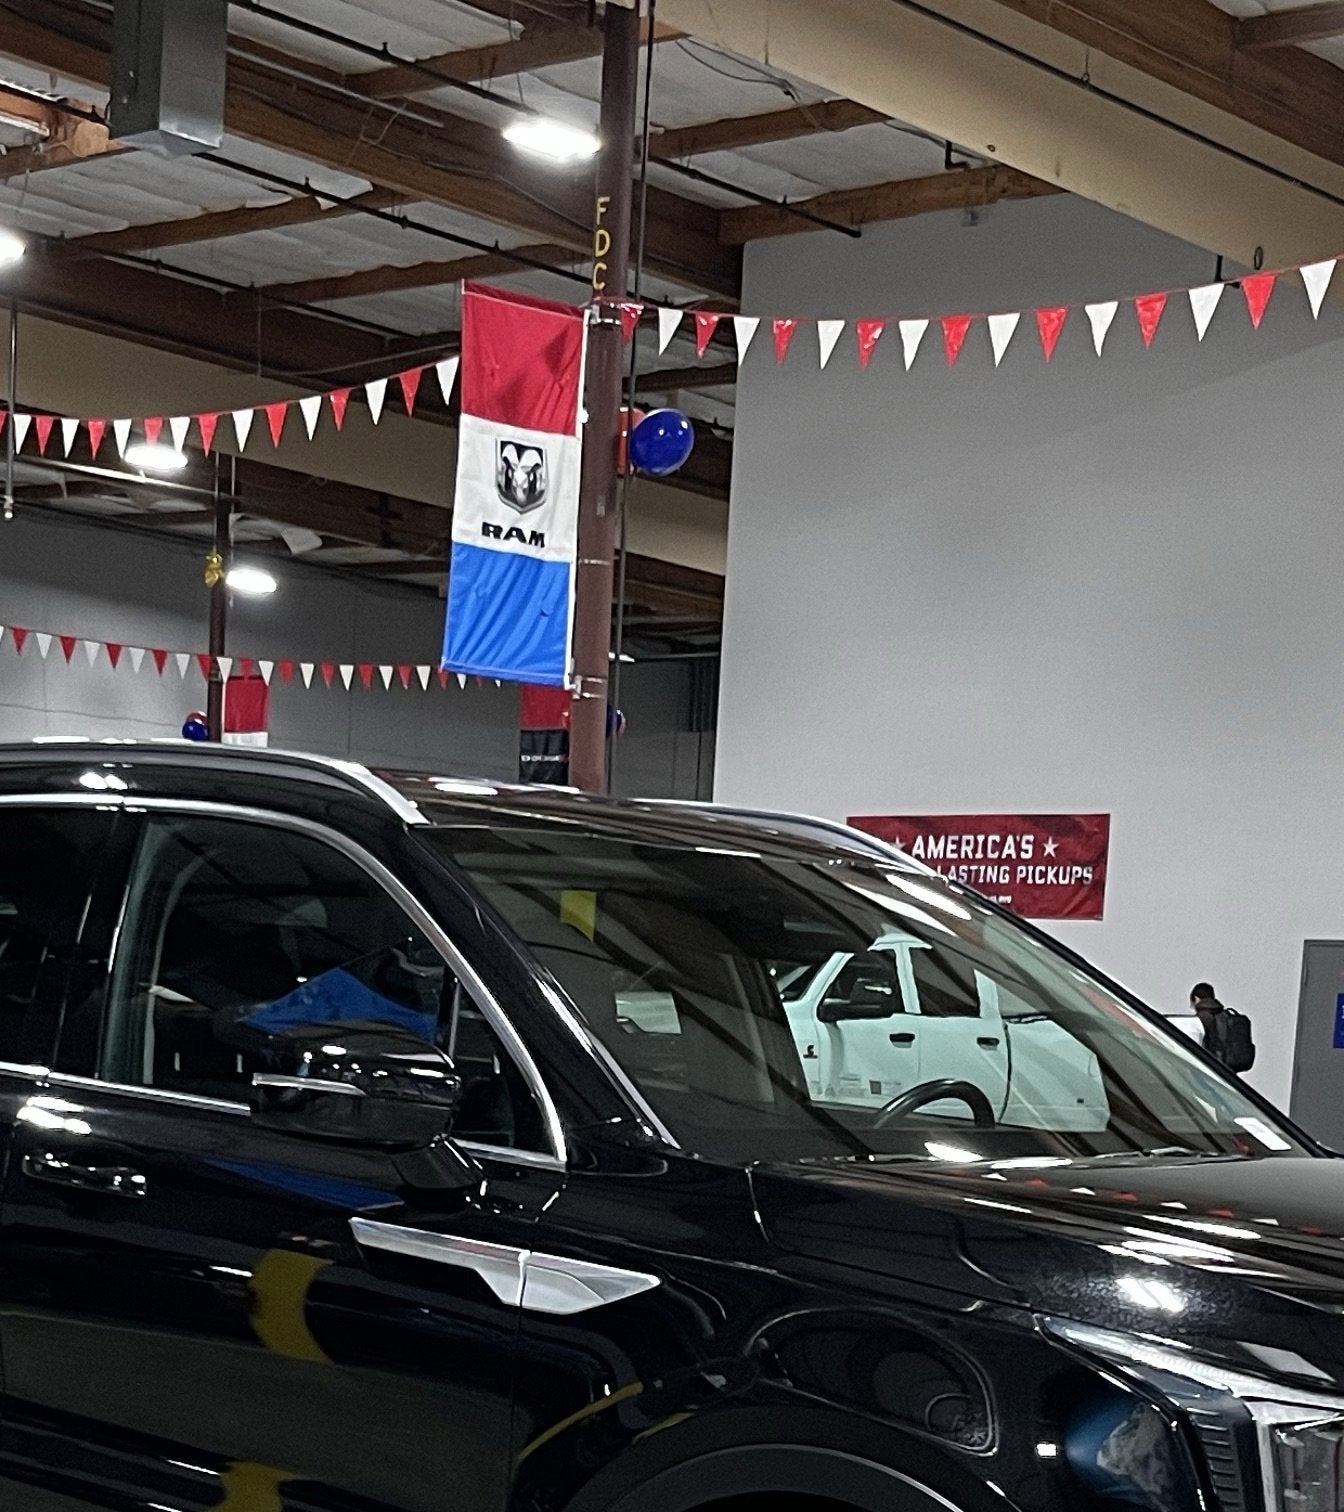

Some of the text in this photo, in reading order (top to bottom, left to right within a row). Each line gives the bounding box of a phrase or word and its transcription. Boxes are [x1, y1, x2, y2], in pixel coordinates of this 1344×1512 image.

[592, 196, 611, 290] FDC
[481, 520, 546, 550] RAM
[911, 834, 1035, 860] AMERICA'S
[1015, 865, 1094, 886] PICKUPS
